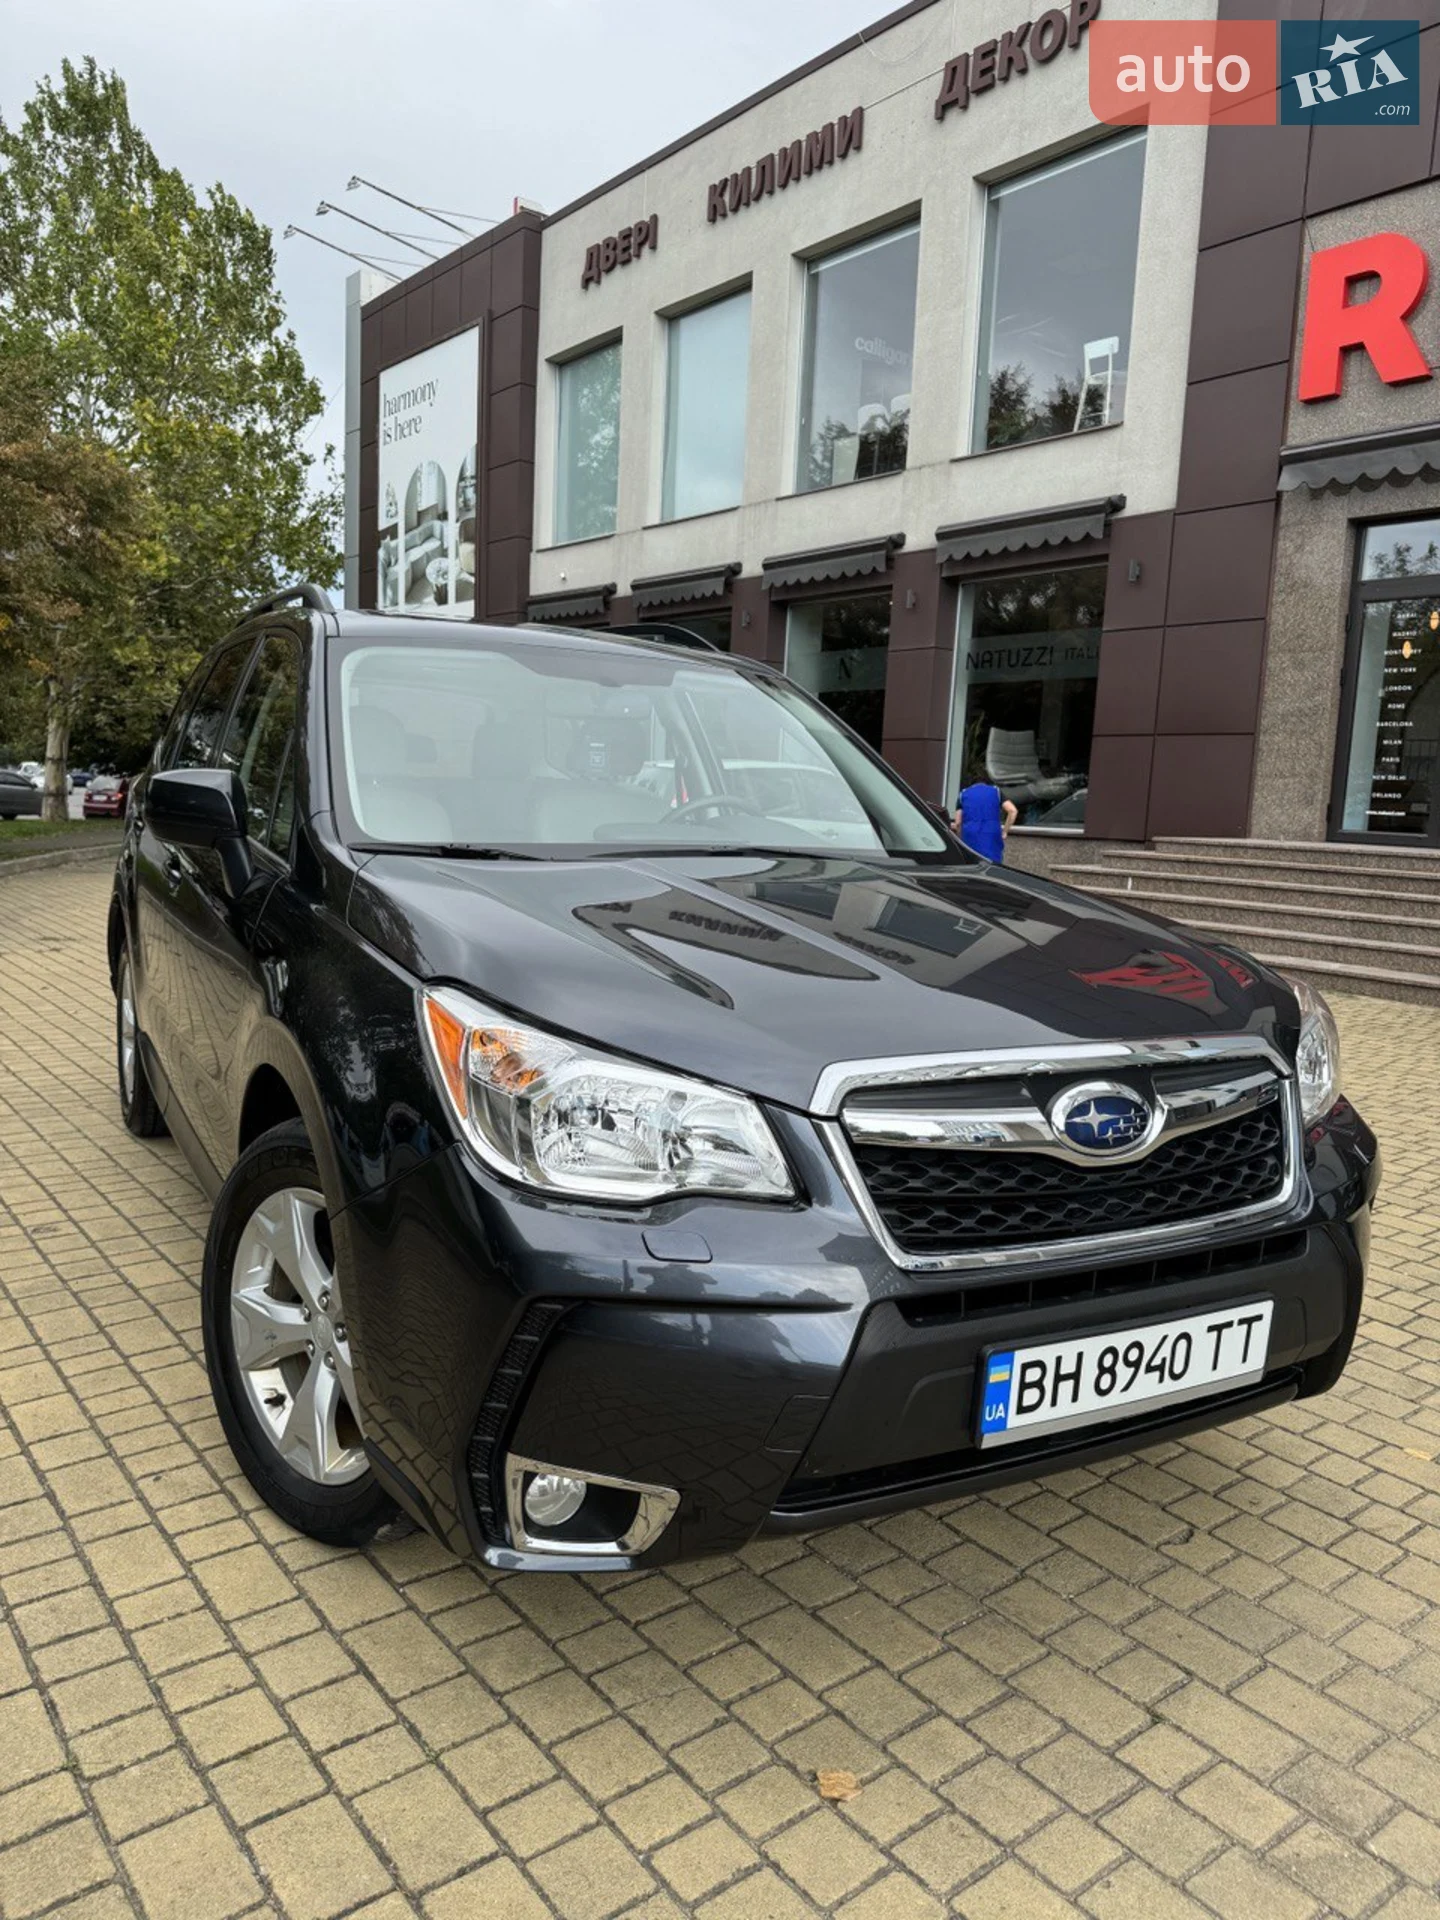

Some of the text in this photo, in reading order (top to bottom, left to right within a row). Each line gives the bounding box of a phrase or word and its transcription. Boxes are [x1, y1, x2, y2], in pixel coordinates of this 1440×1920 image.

[934, 0, 1102, 122] ДЕКОР
[707, 105, 865, 223] КИЛИМИ
[581, 213, 659, 291] ДВЕРІ
[1297, 232, 1433, 403] R
[382, 378, 439, 418] harmony
[382, 415, 423, 446] is here
[965, 646, 1055, 671] NATUZZI
[1384, 666, 1398, 674] NEW
[1384, 684, 1412, 692] LONDON
[1387, 702, 1406, 710] ROME
[1376, 720, 1413, 728] BARCELONA
[1382, 738, 1402, 746] MILAN
[1016, 1314, 1264, 1416] BH 8940 TT
[985, 1404, 1005, 1422] UA
